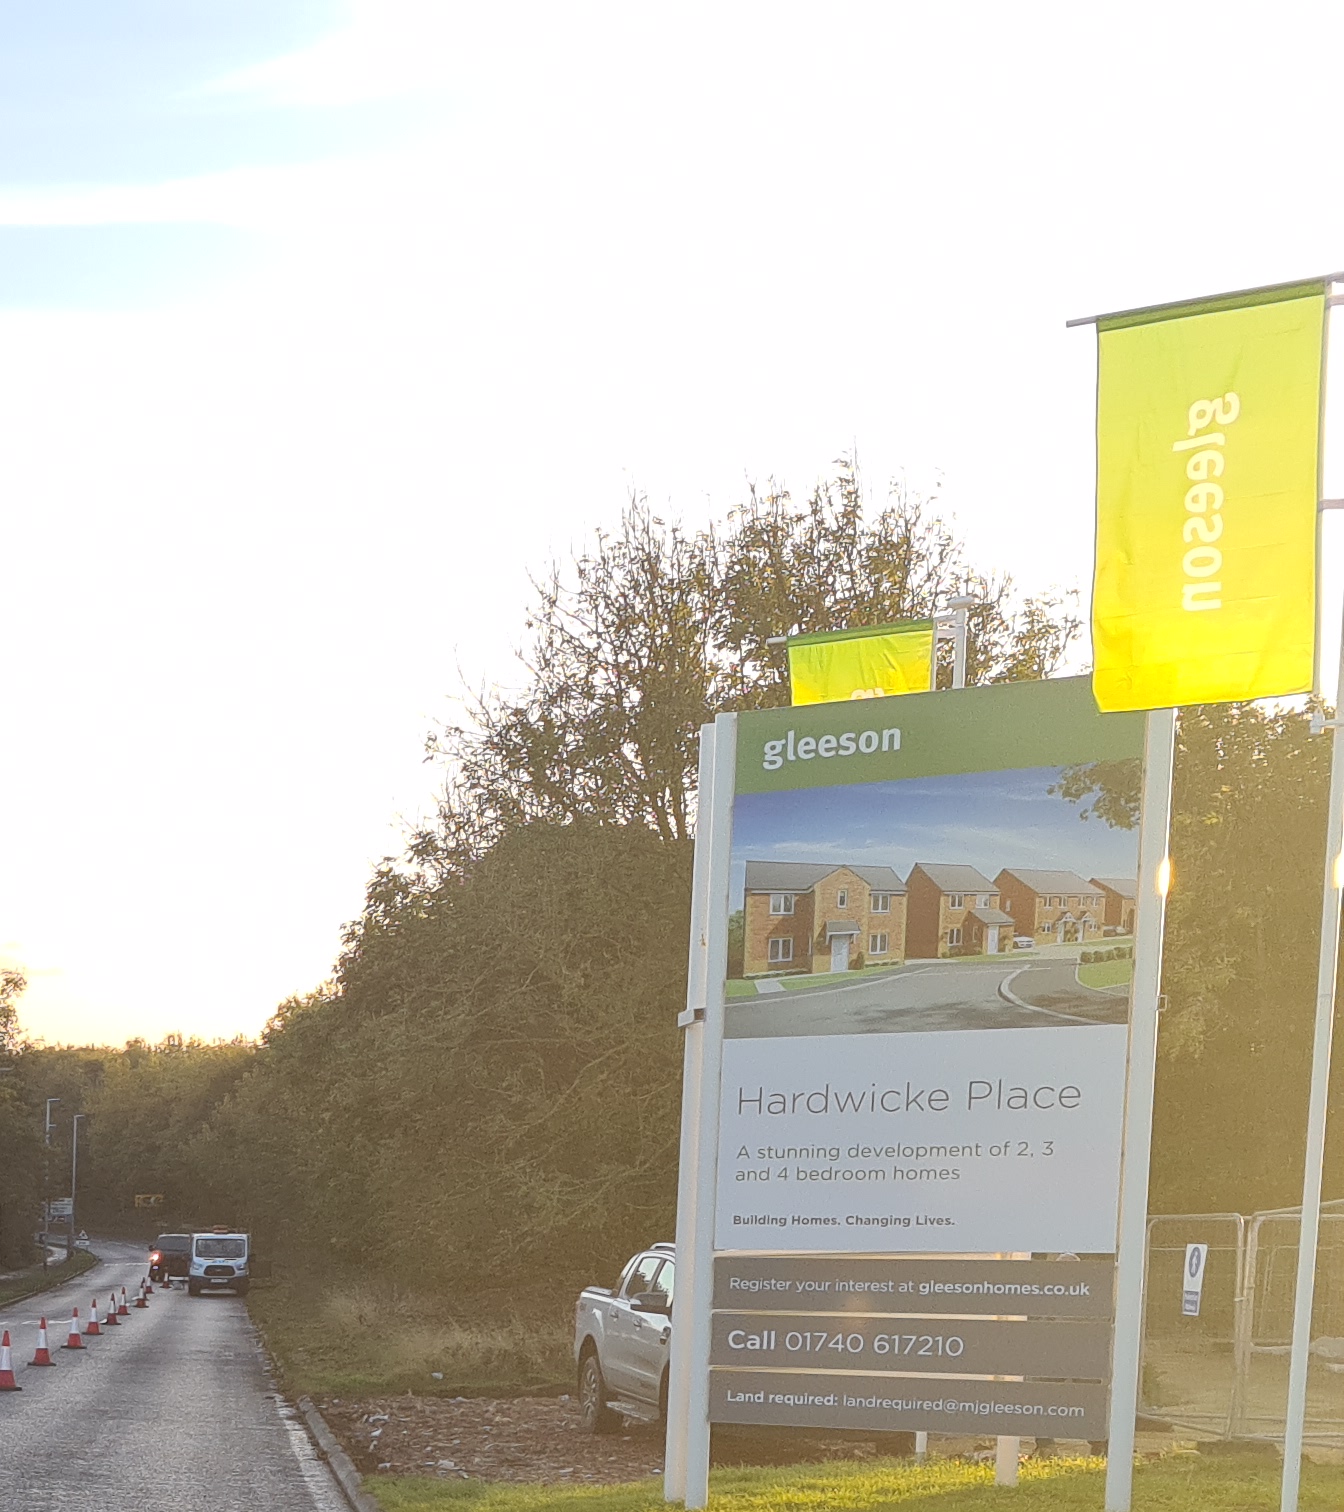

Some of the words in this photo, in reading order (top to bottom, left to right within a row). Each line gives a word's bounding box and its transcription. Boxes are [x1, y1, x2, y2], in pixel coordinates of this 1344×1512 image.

[762, 727, 901, 770] gleeson
[737, 1082, 949, 1115] Hardwicke
[967, 1079, 1081, 1111] Place
[737, 1145, 750, 1159] A
[757, 1144, 840, 1161] stunning
[847, 1142, 981, 1161] development
[989, 1141, 1011, 1157] of
[1017, 1142, 1034, 1158] 2,
[1042, 1141, 1054, 1156] 3
[735, 1167, 770, 1181] and
[777, 1168, 789, 1180] 4
[797, 1166, 886, 1180] bedroom
[893, 1166, 960, 1180] homes
[733, 1215, 787, 1227] Building
[792, 1215, 840, 1226] Homes.
[846, 1215, 910, 1227] Changing
[916, 1215, 955, 1226] Lives.
[730, 1278, 791, 1293] Register
[796, 1280, 831, 1293] your
[835, 1279, 894, 1293] interest
[899, 1280, 914, 1293] at
[919, 1281, 1090, 1297] gleesonhomes.co.uk
[728, 1330, 775, 1350] Call
[785, 1332, 863, 1353] 01740
[873, 1334, 964, 1357] 617210
[727, 1390, 764, 1403] Land
[769, 1392, 838, 1408] required:
[843, 1395, 1084, 1417] landrequired@mjgleeson.com
